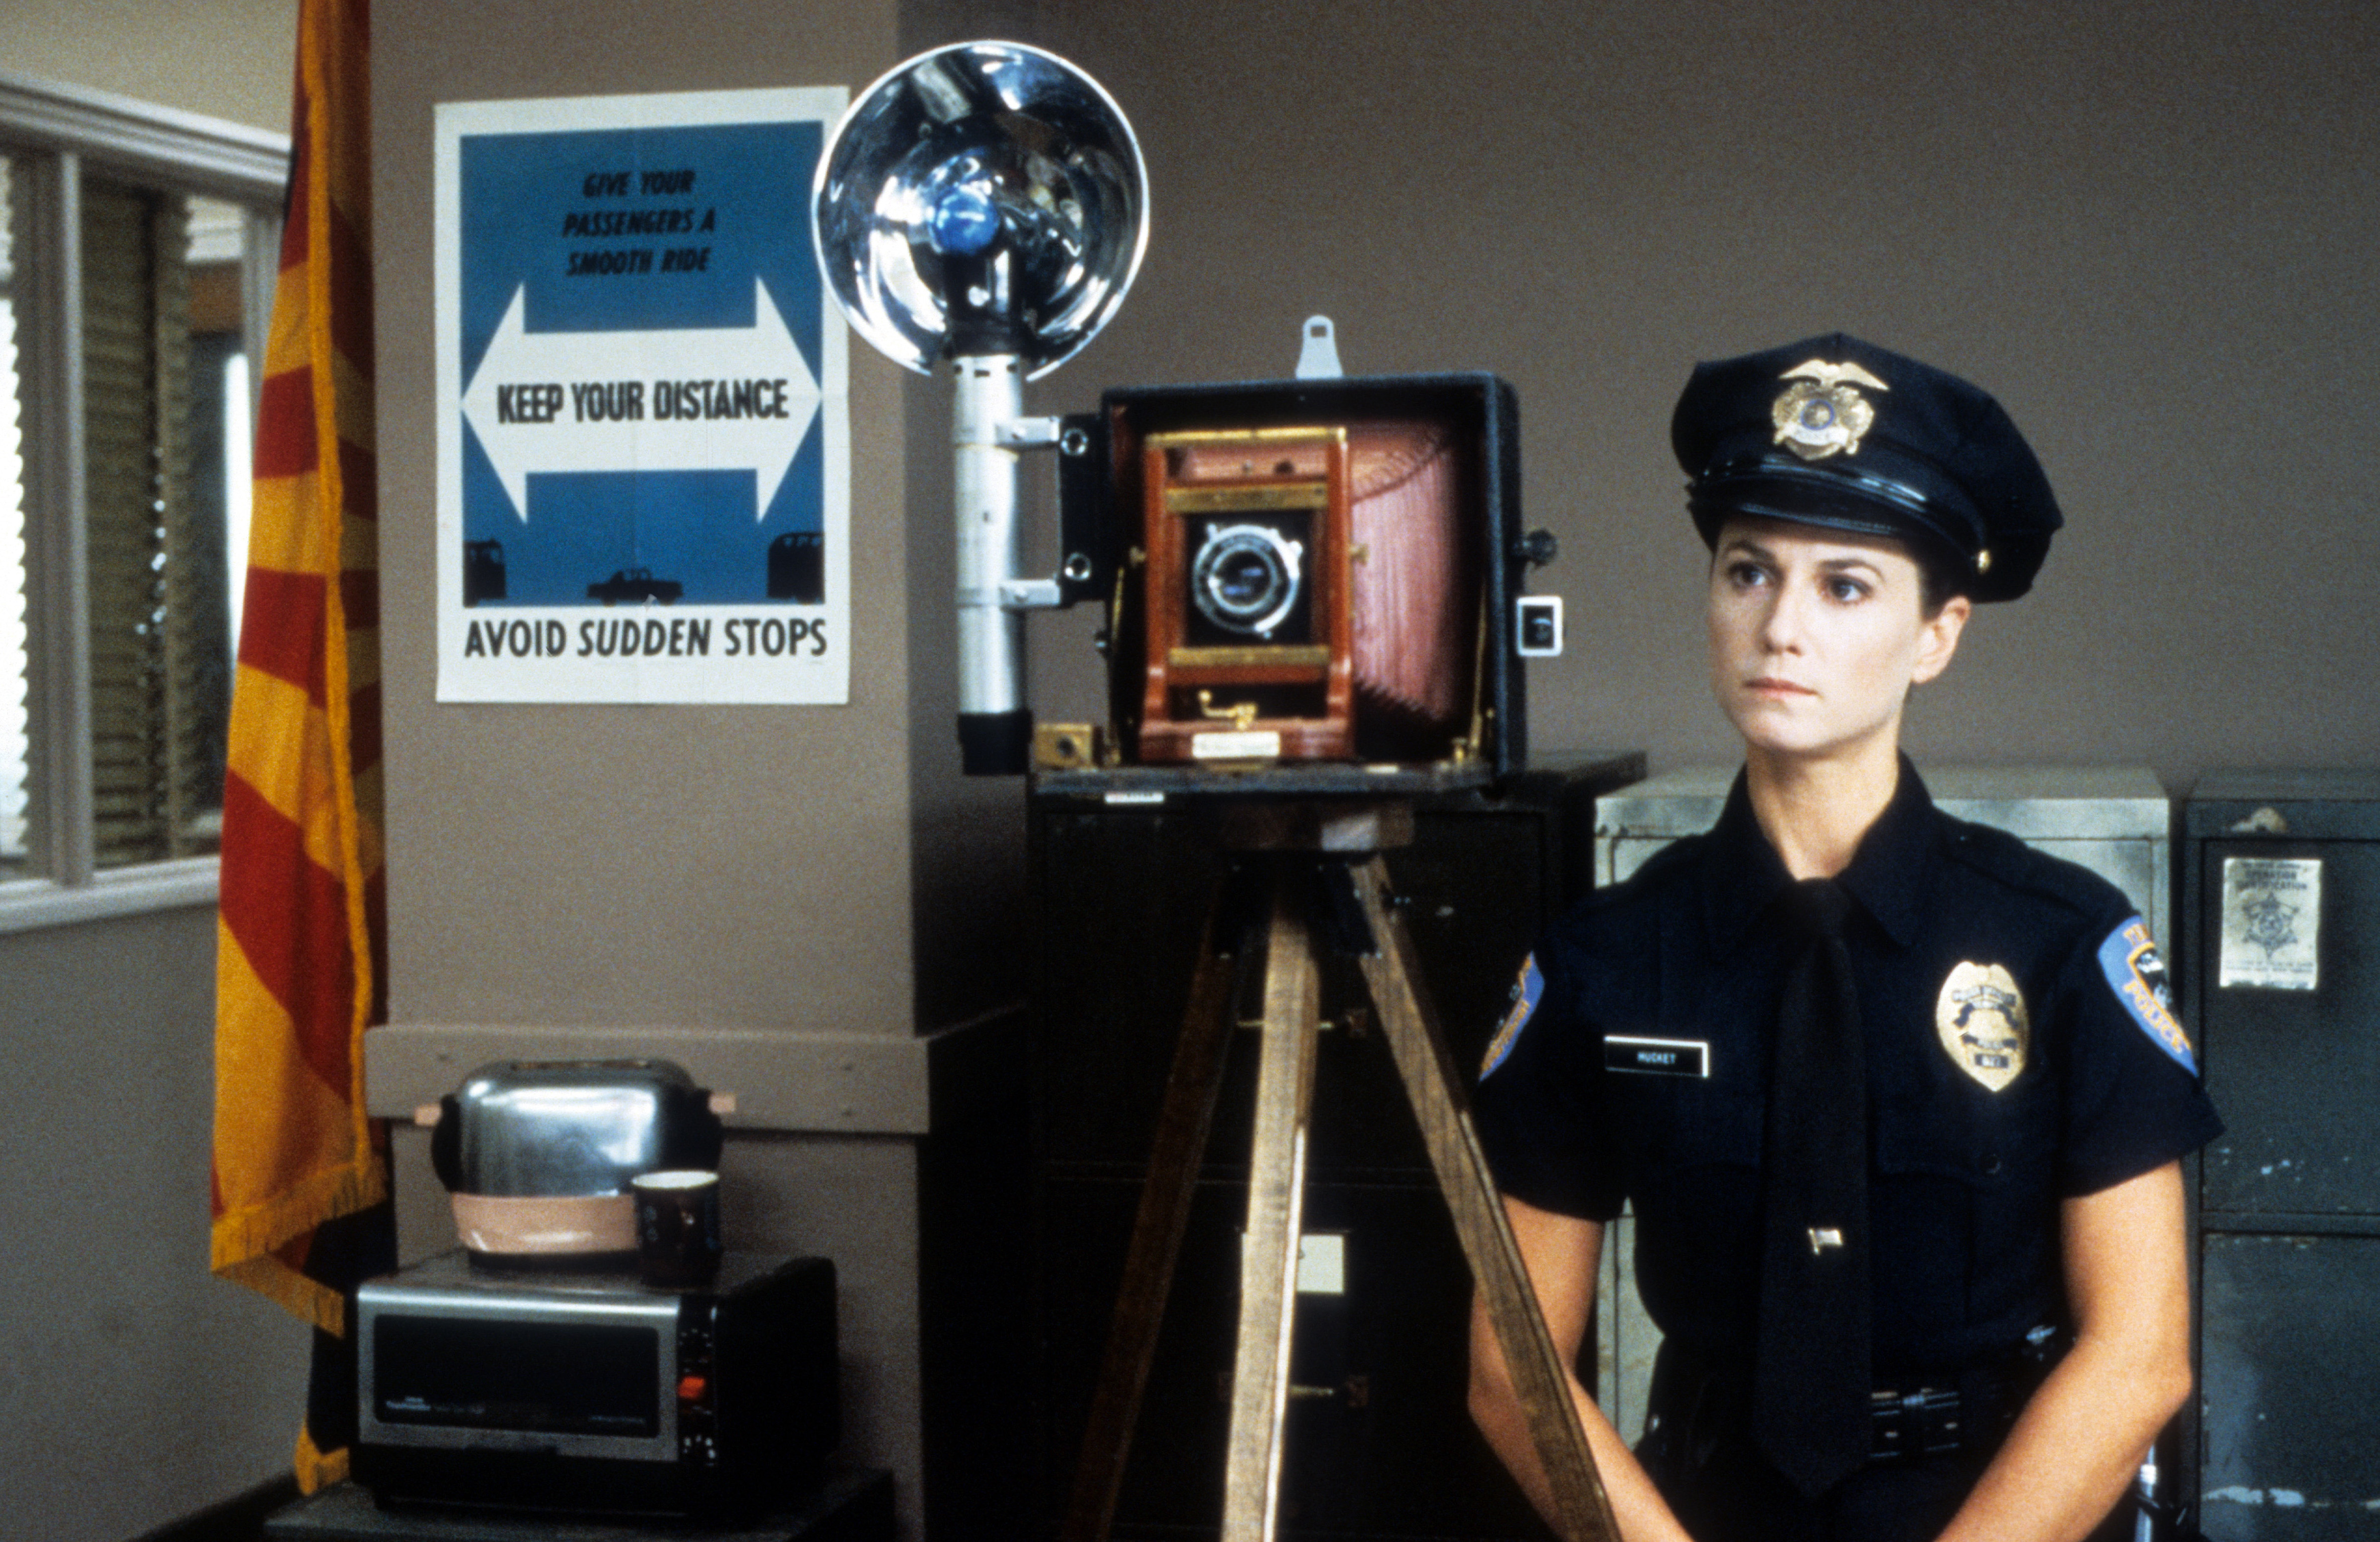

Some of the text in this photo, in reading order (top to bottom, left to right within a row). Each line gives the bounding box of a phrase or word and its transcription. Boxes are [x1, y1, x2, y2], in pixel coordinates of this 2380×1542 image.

[583, 170, 695, 198] GIVE YOUR
[562, 209, 715, 237] PASSENGERS A
[567, 246, 711, 276] SMOOTH RIDE
[497, 378, 788, 424] KEEP YOUR DISTANCE
[465, 617, 827, 658] AVOID SUDDEN STOPS
[2122, 979, 2182, 1054] POLICE
